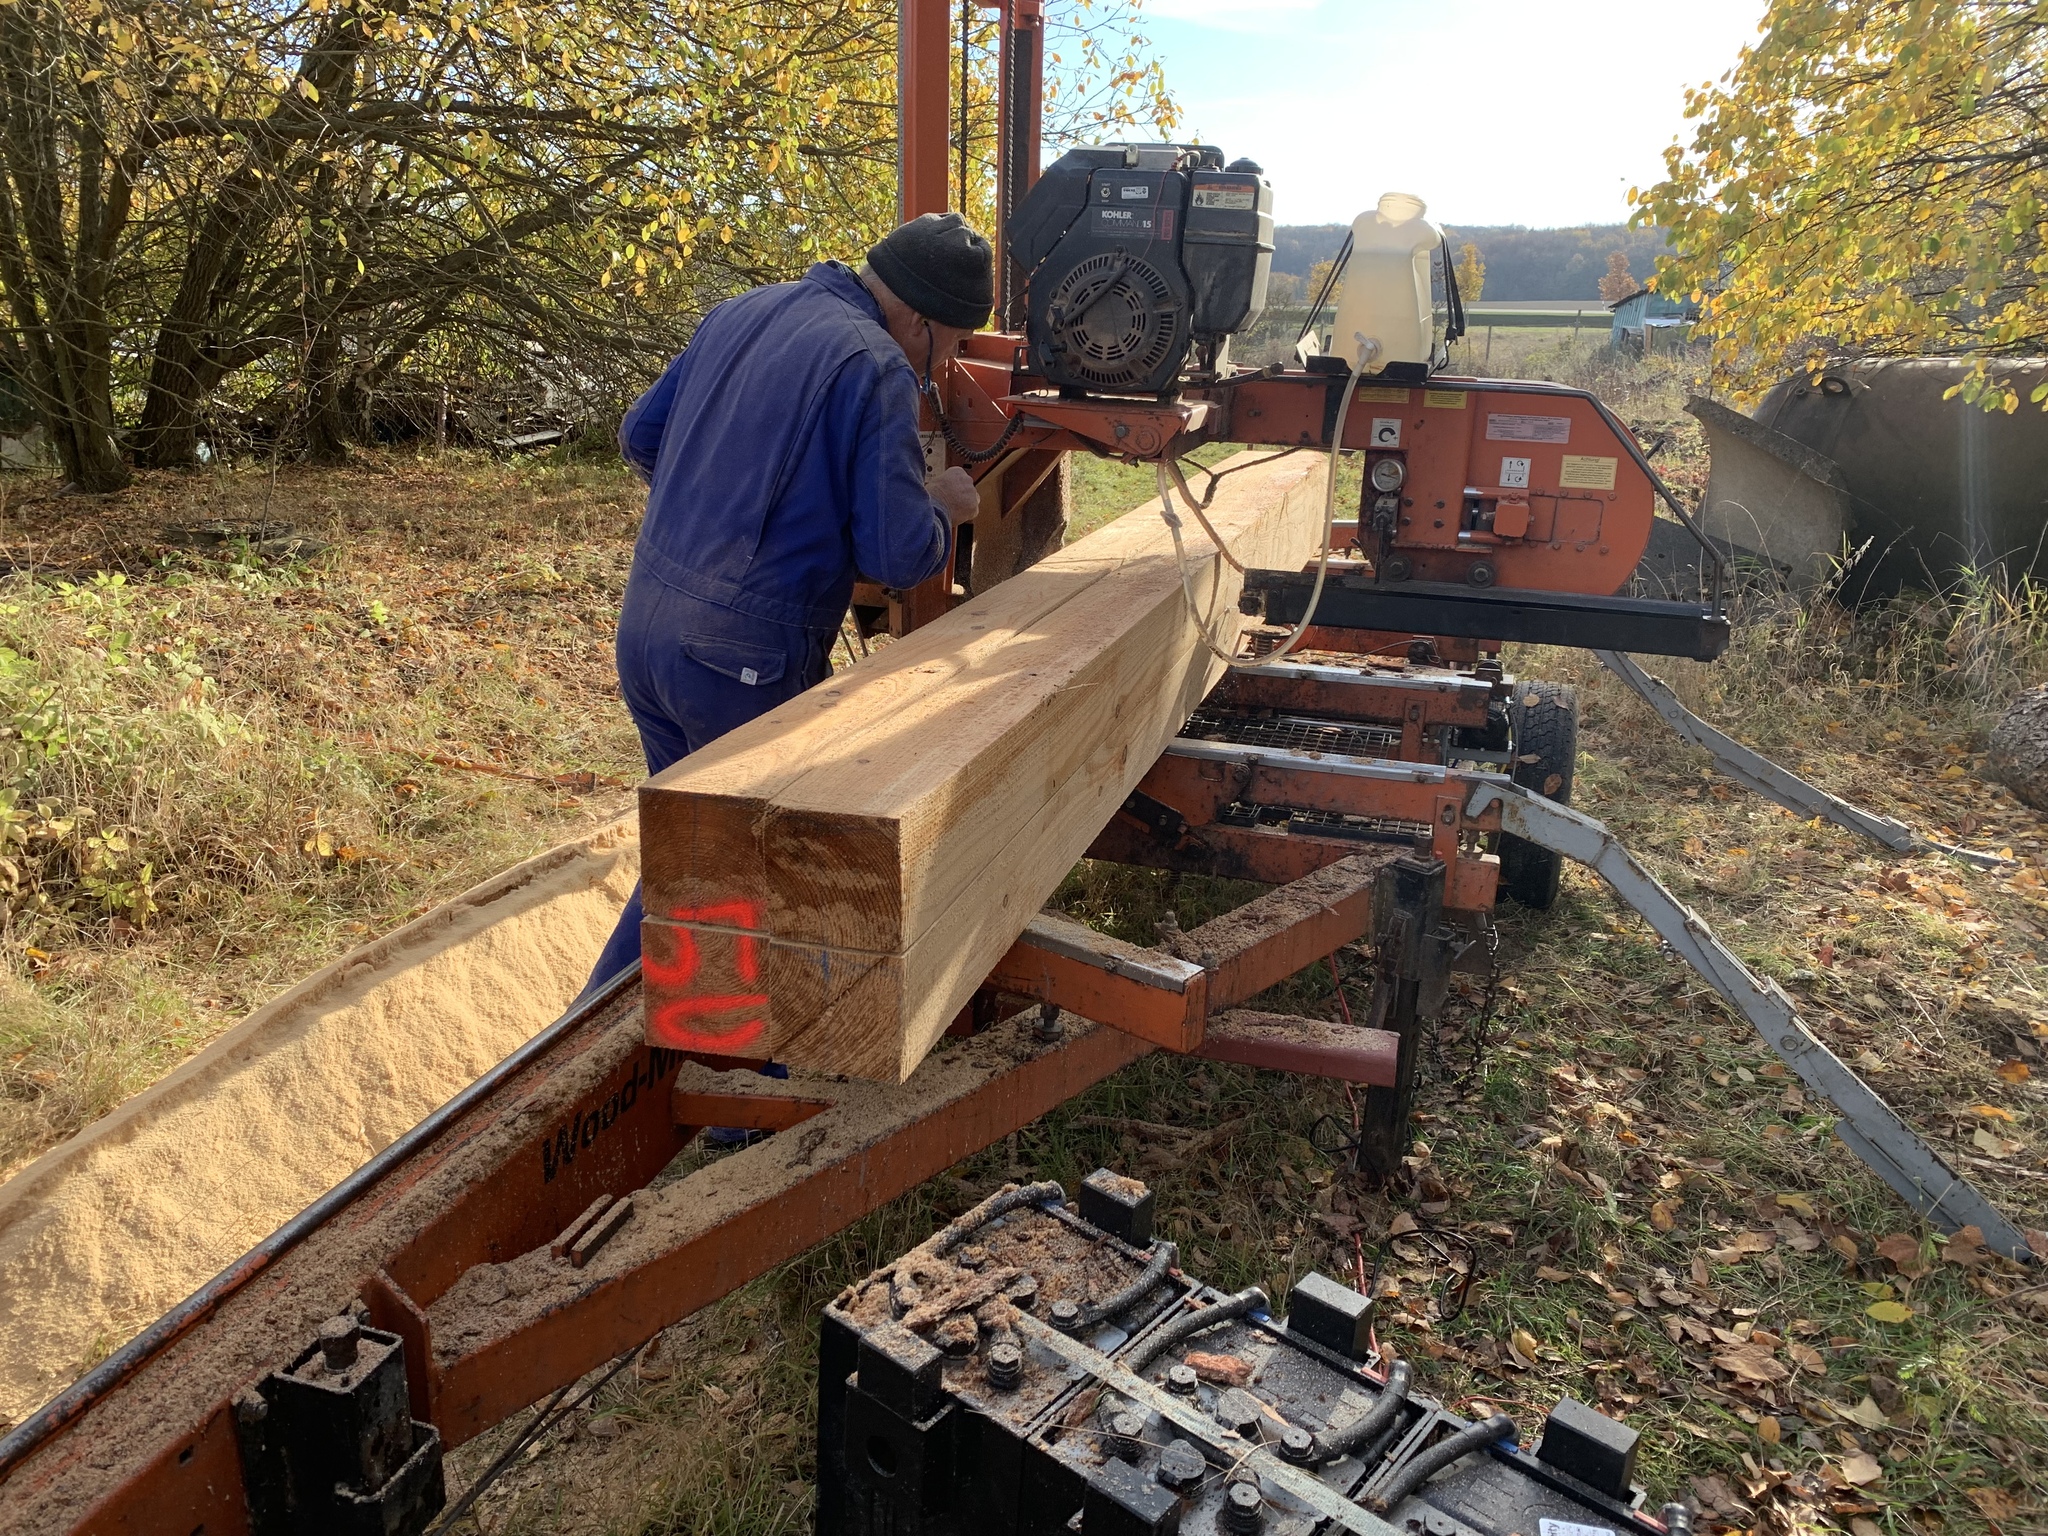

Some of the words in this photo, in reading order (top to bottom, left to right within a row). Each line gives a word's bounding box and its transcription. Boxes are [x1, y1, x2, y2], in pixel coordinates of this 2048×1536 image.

[1101, 210, 1132, 219] KOHLER
[1143, 220, 1152, 228] 15
[542, 1048, 690, 1185] Wood-M
